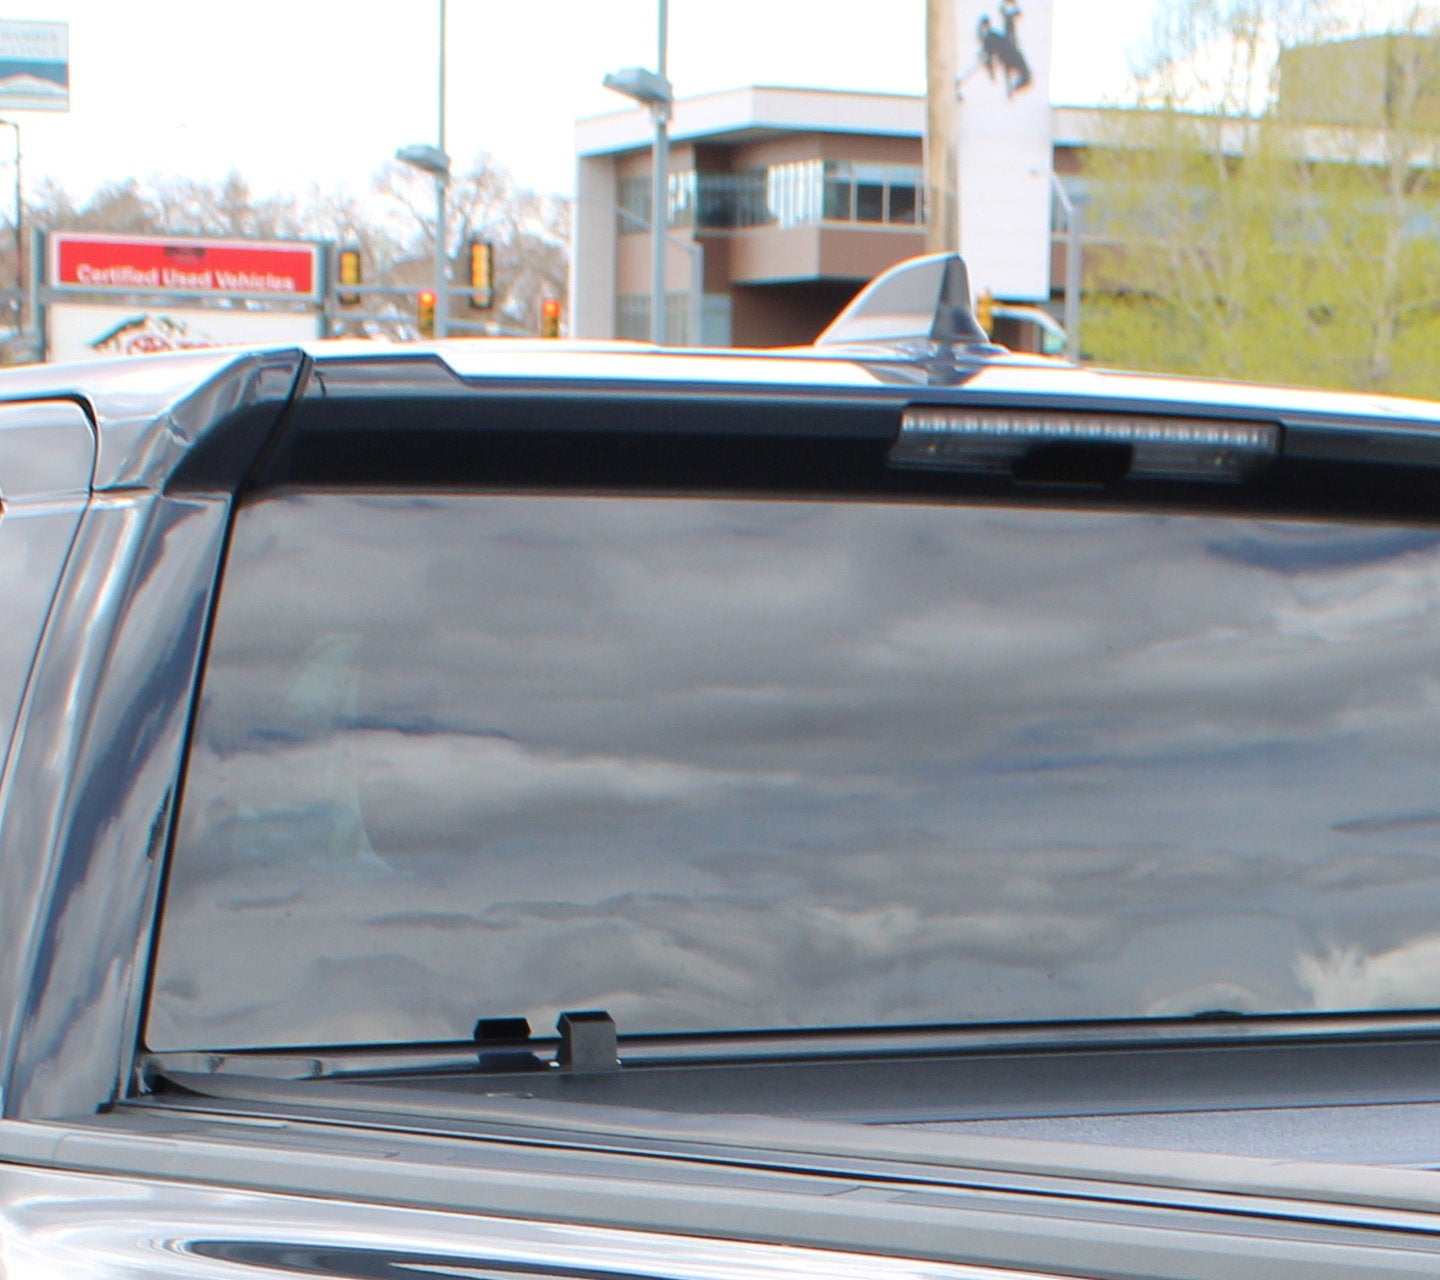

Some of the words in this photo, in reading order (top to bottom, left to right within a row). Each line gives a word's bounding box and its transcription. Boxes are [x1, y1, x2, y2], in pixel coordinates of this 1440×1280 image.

[75, 263, 159, 287] Certified
[161, 269, 211, 289] Used
[214, 270, 297, 292] Vehicles
